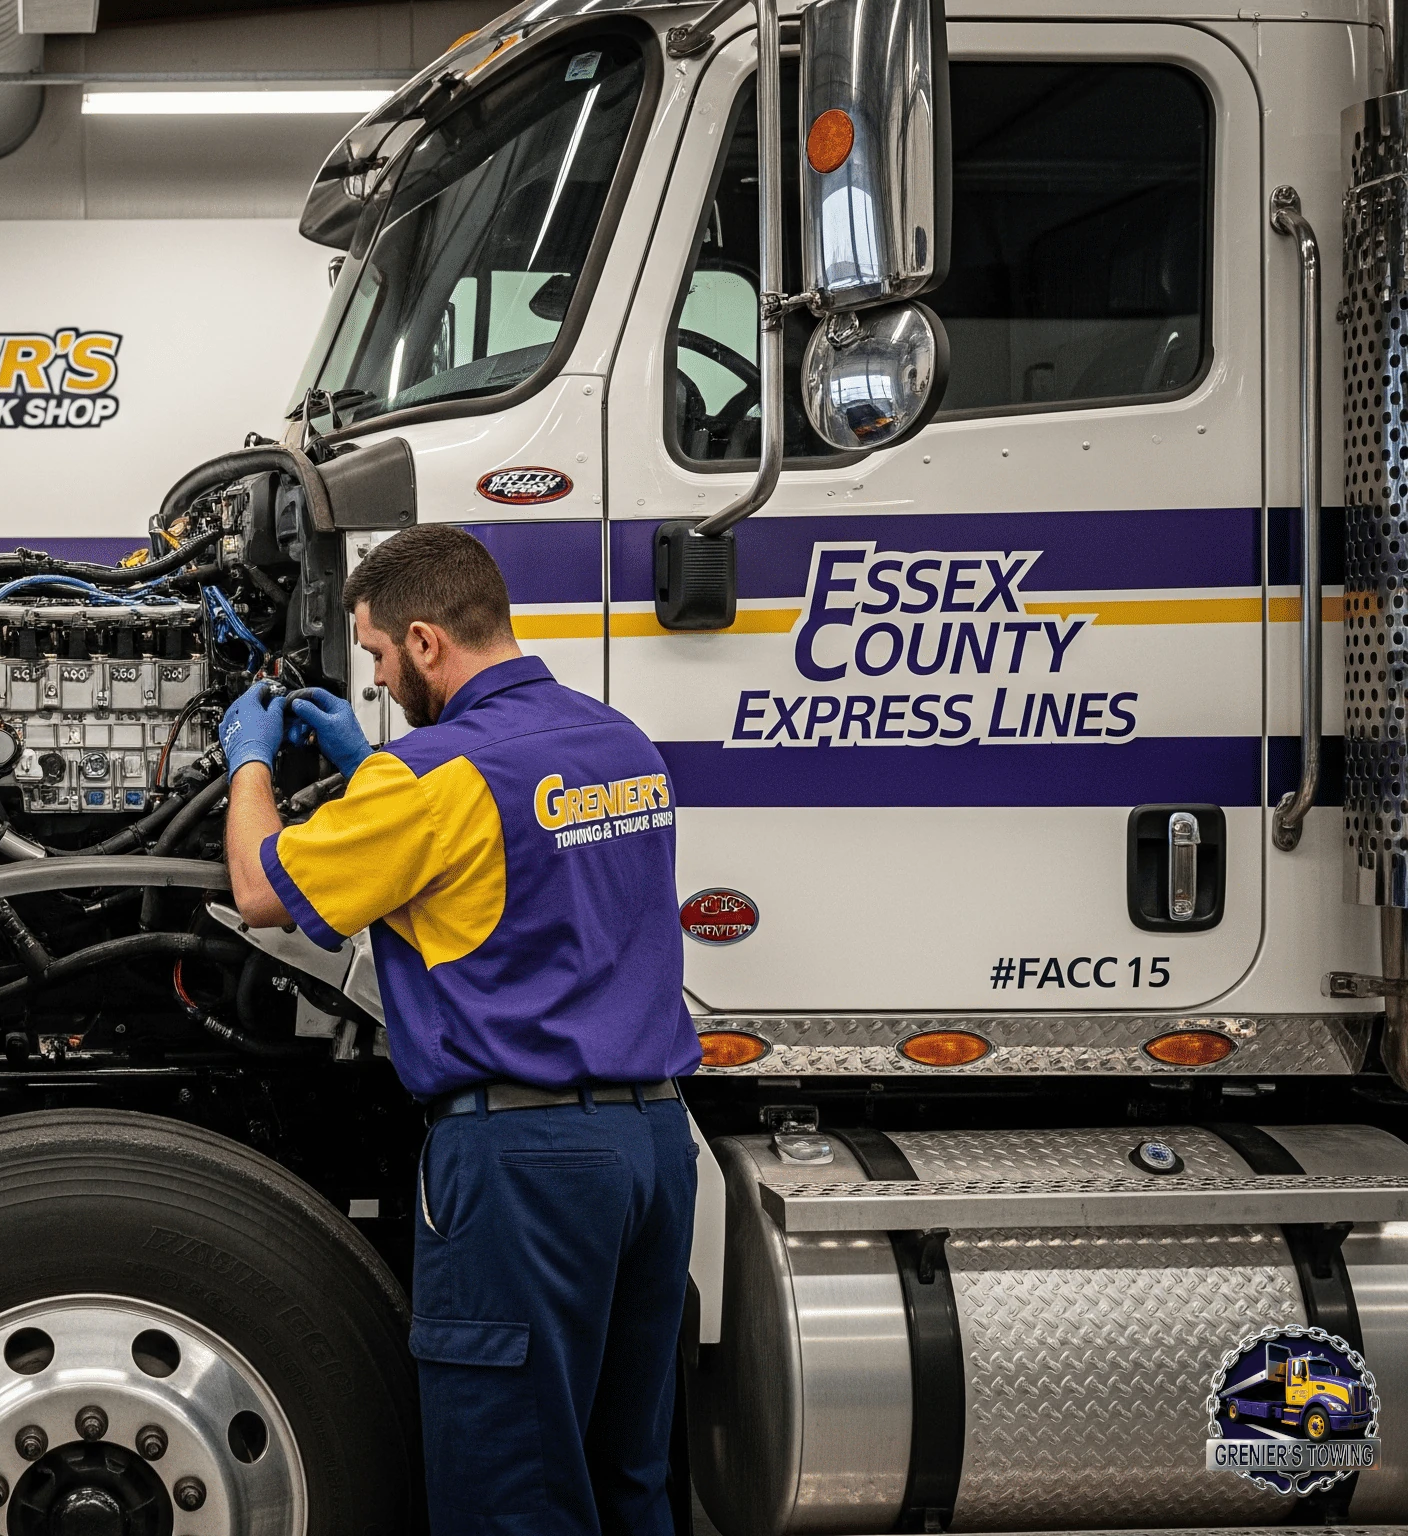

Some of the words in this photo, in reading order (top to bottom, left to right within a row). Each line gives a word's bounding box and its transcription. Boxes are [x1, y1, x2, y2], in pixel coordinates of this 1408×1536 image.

[23, 399, 118, 427] SHOP
[809, 550, 1028, 614] ESSEX
[795, 609, 1087, 682] COUNTY
[731, 689, 974, 740] EXPRESS
[988, 687, 1139, 738] LINES
[534, 773, 670, 831] GRENIER'S
[990, 956, 1118, 989] #FACC
[1127, 956, 1171, 988] 15
